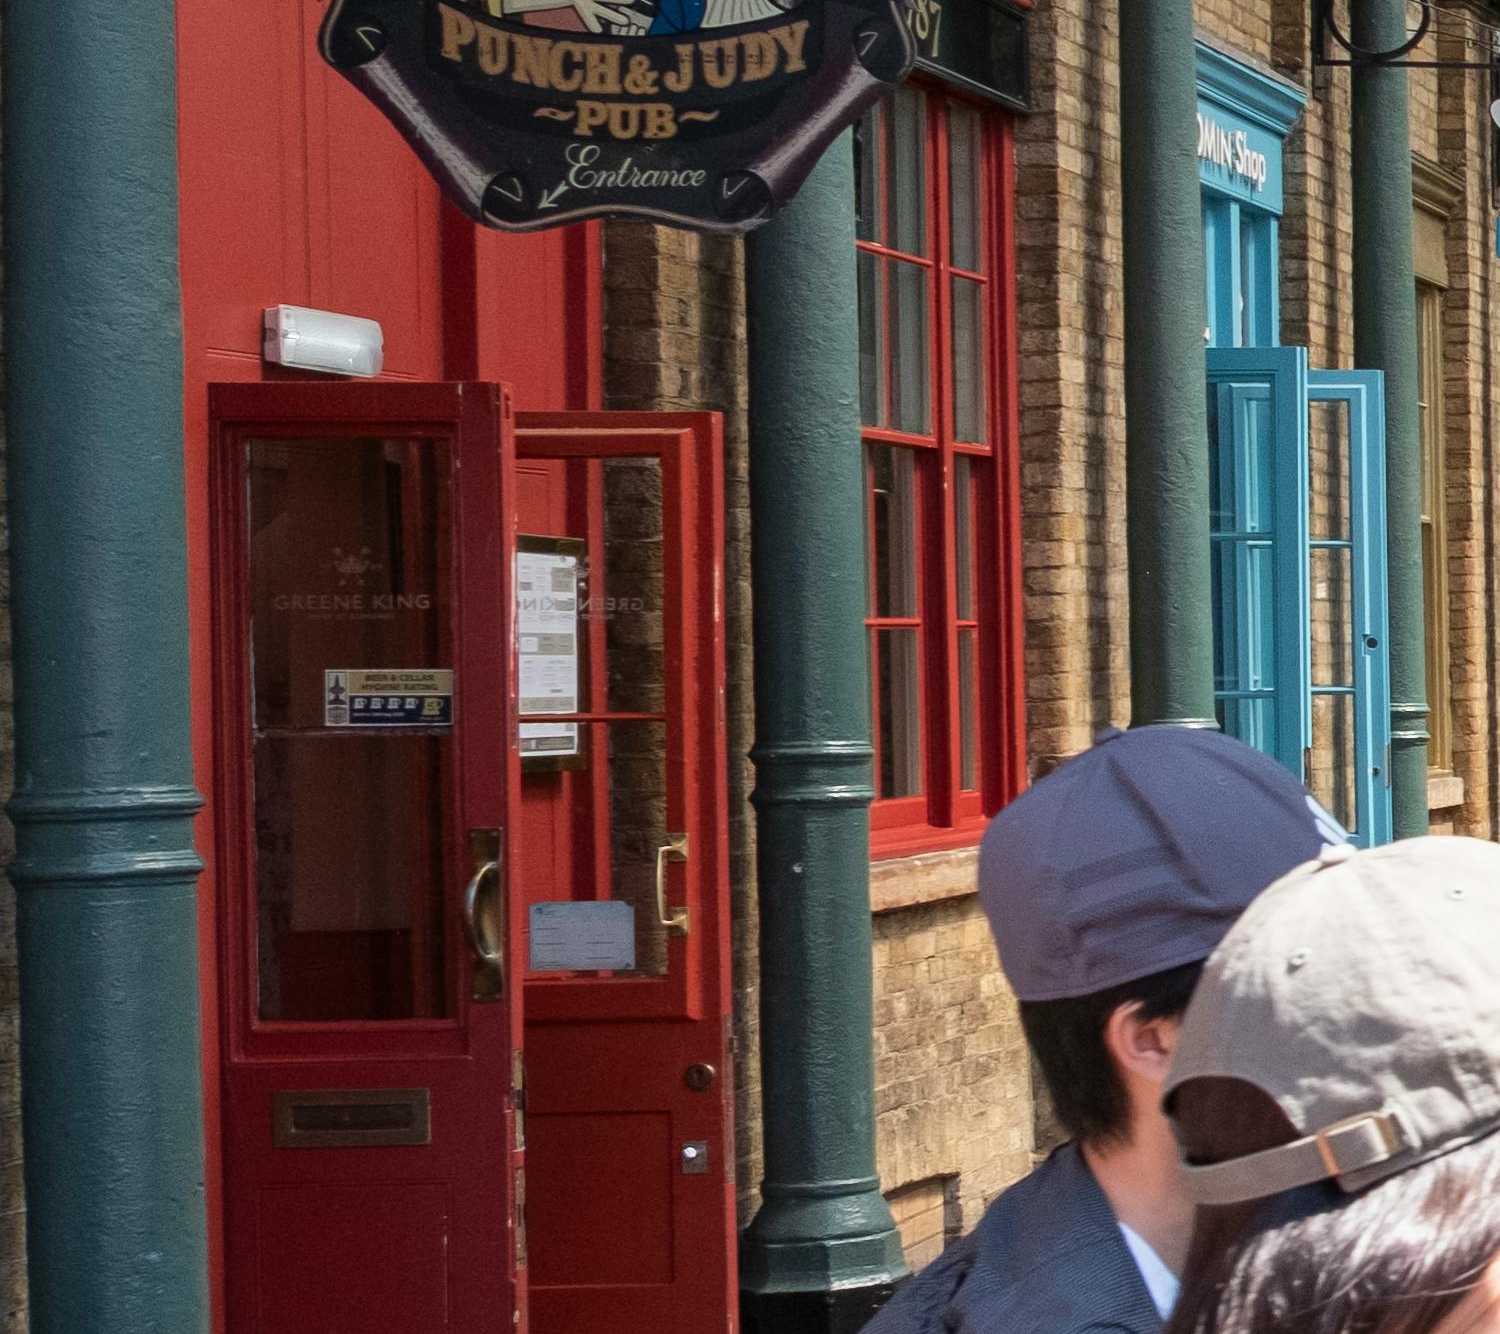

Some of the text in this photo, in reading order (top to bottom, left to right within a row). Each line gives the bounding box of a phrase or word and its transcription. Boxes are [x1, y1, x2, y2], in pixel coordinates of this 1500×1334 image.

[438, 3, 810, 95] PUNCH & JUDY
[574, 99, 678, 139] PUB
[565, 143, 707, 188] Entrance
[1235, 130, 1266, 192] Shop
[273, 594, 432, 610] GREENE KING
